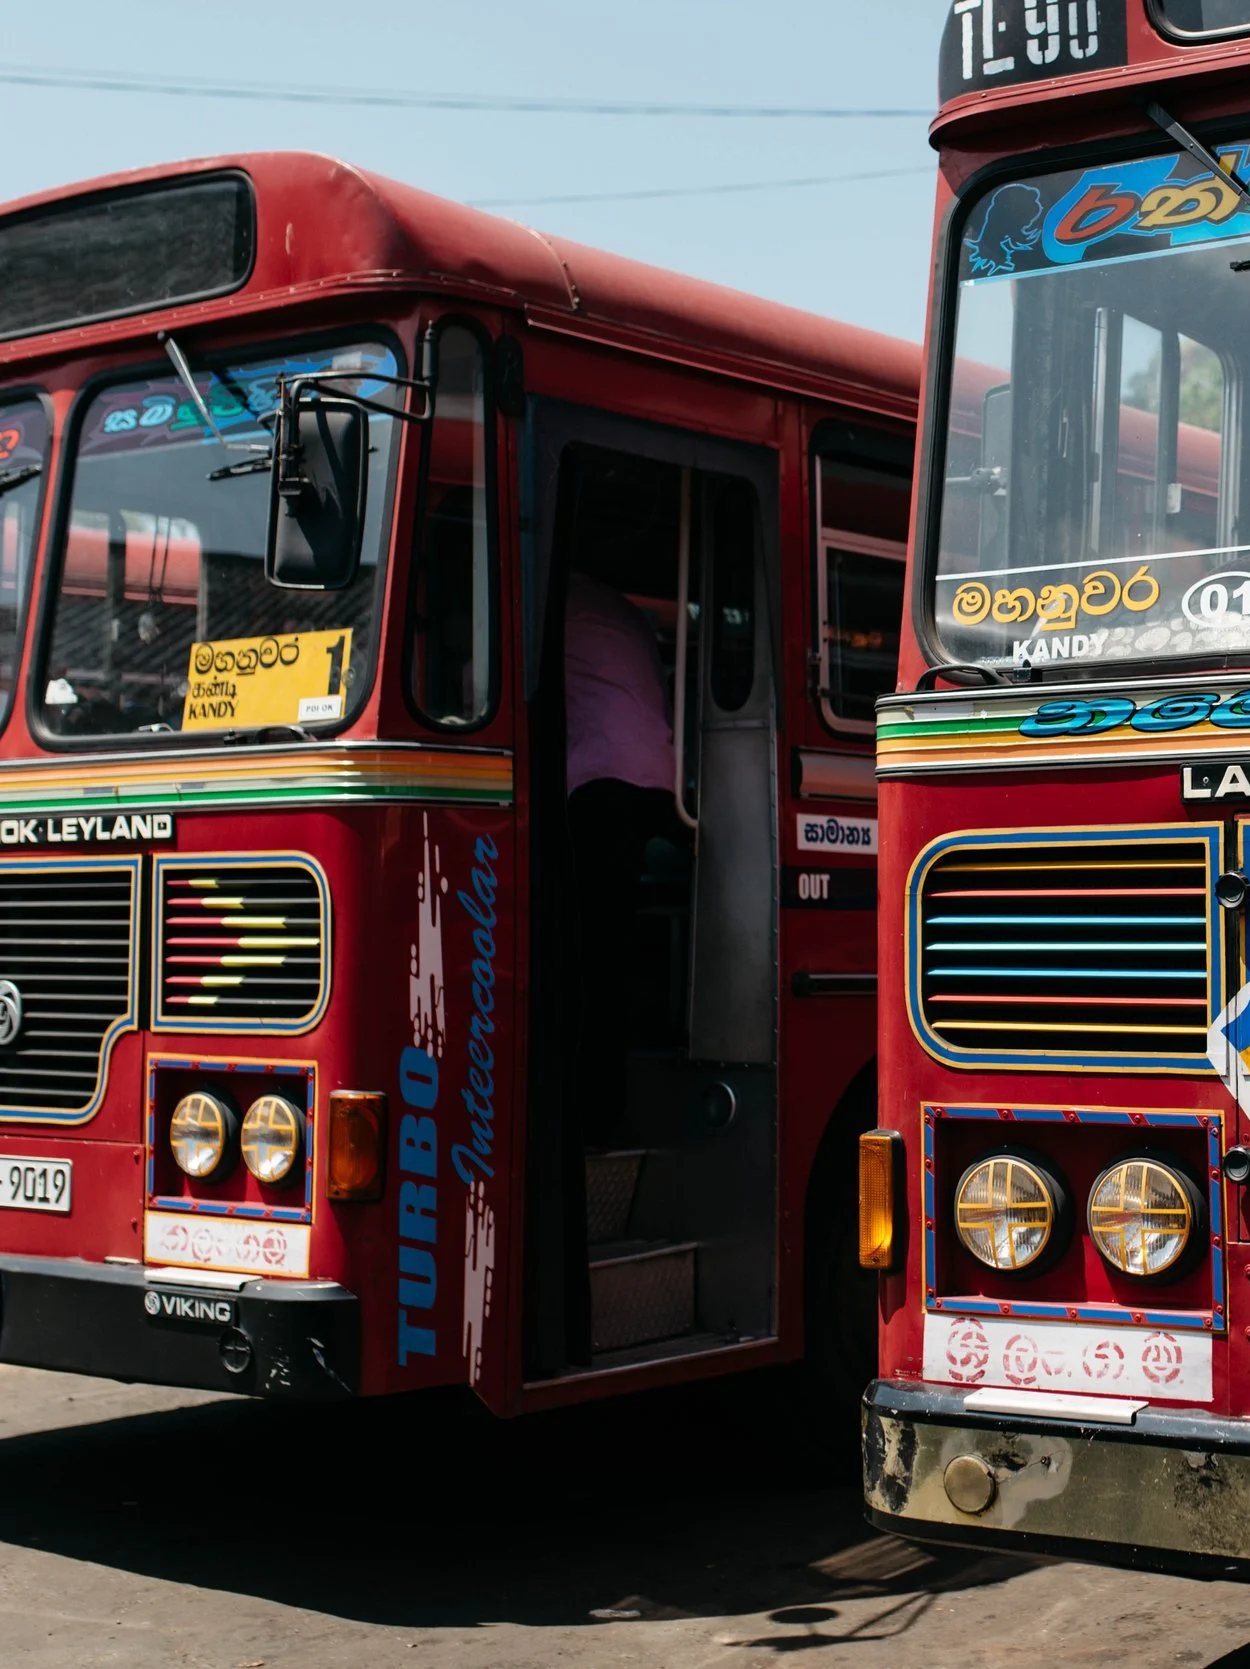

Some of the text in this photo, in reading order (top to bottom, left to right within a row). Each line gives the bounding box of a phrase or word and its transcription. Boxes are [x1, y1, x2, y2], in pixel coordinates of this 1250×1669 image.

[952, 565, 1160, 631] මහනුවර
[194, 635, 300, 676] මහනුවර
[1013, 633, 1107, 664] KANDY
[188, 700, 238, 720] KANDY
[0, 813, 173, 844] OK LEYLAND
[798, 873, 831, 900] OUT
[10, 1165, 66, 1204] 9019
[399, 1045, 441, 1366] TURBO
[162, 1295, 231, 1322] VIKING
